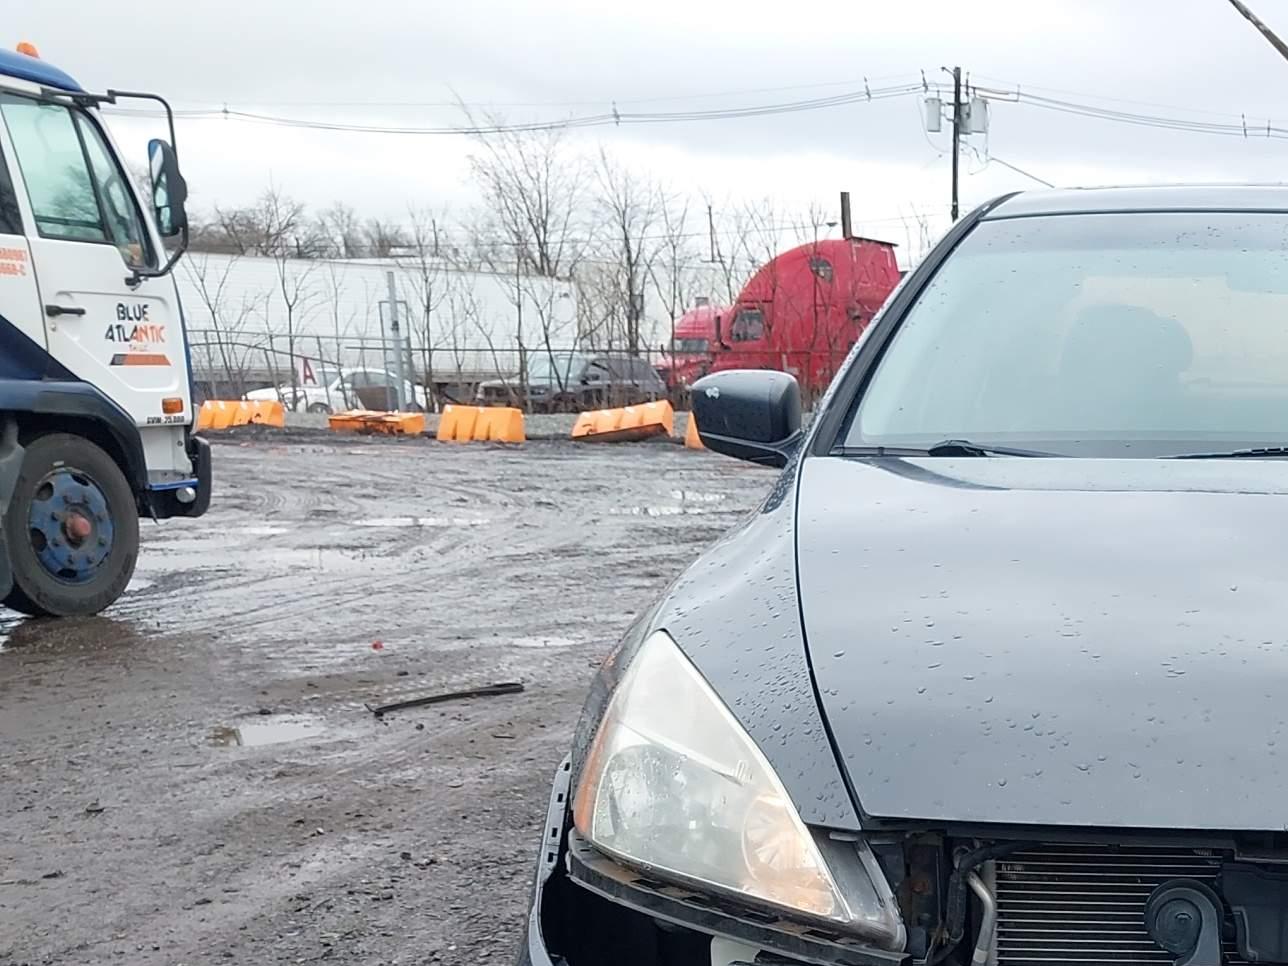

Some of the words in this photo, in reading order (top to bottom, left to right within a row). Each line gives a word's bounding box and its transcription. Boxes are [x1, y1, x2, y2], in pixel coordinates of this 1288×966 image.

[116, 302, 150, 321] BLUE
[105, 324, 165, 343] ATLANTIC
[303, 357, 317, 385] A
